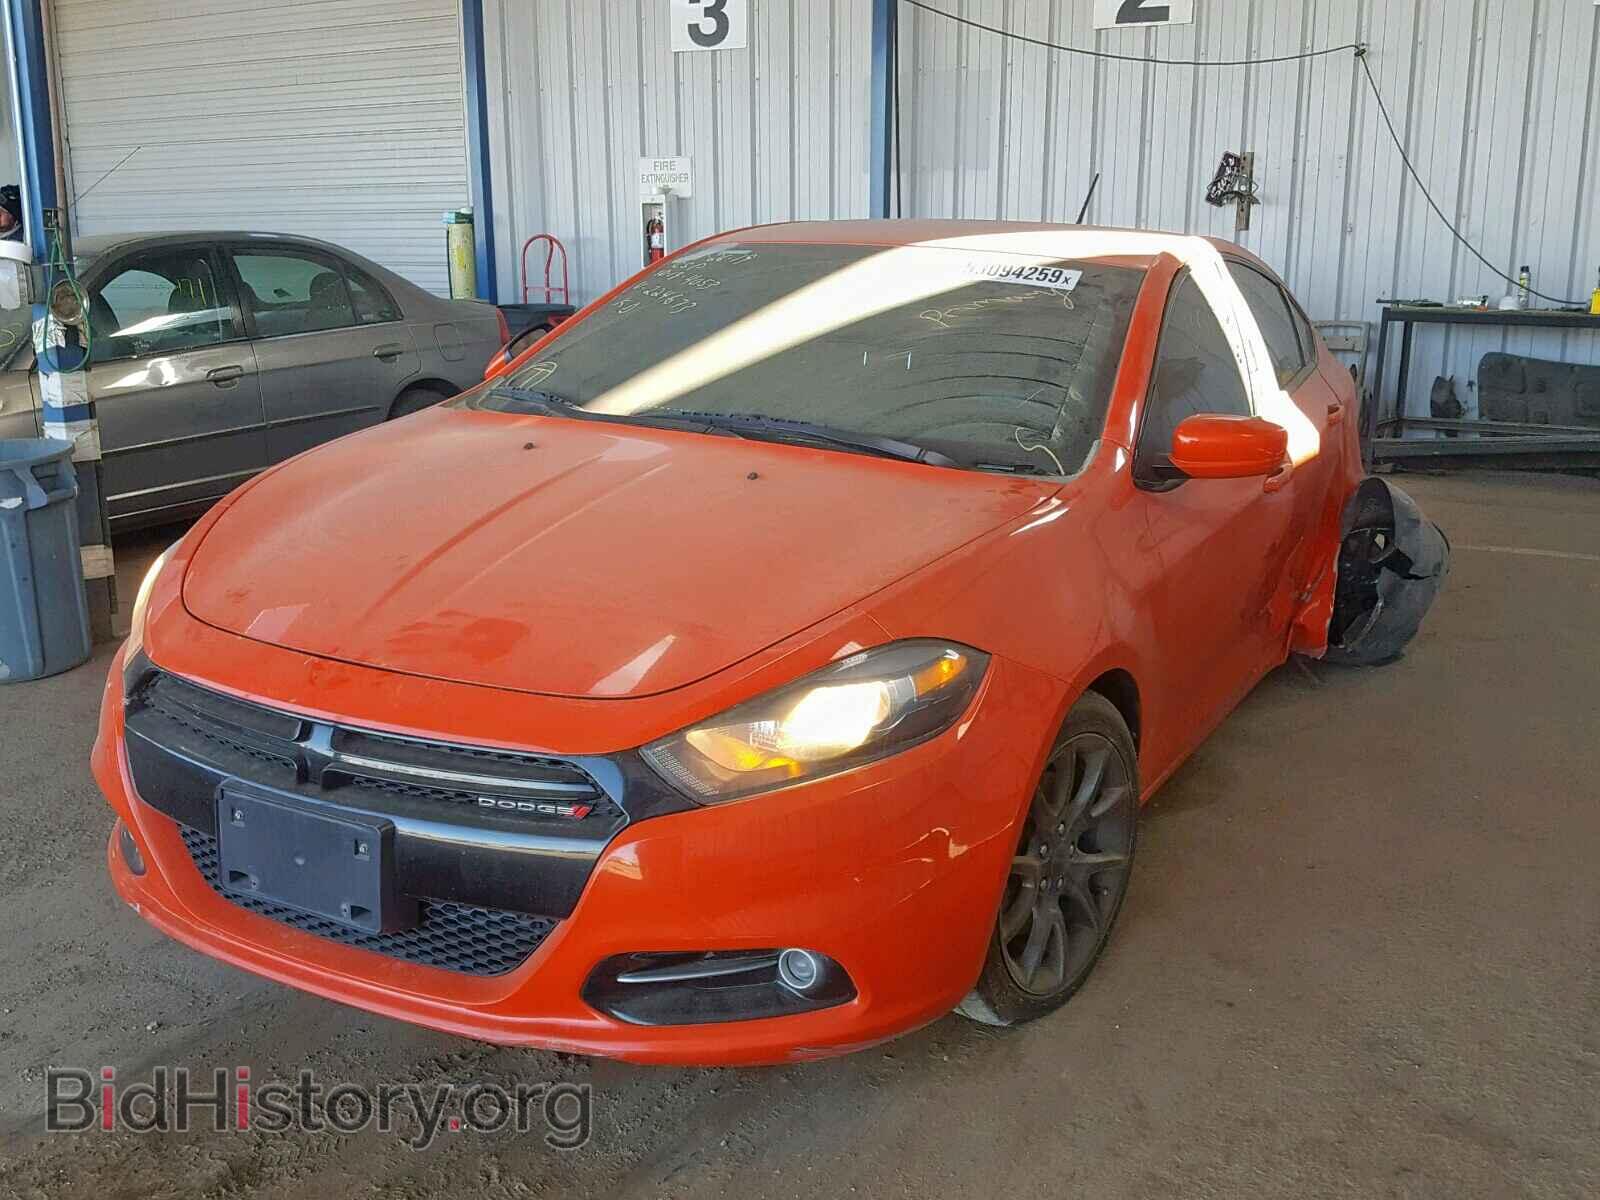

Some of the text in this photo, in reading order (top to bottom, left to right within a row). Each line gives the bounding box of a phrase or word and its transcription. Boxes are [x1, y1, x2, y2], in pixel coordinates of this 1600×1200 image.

[687, 0, 729, 47] 3
[653, 160, 677, 171] FIRE
[641, 172, 689, 184] EXTINGUISHER
[478, 798, 575, 816] DODGE
